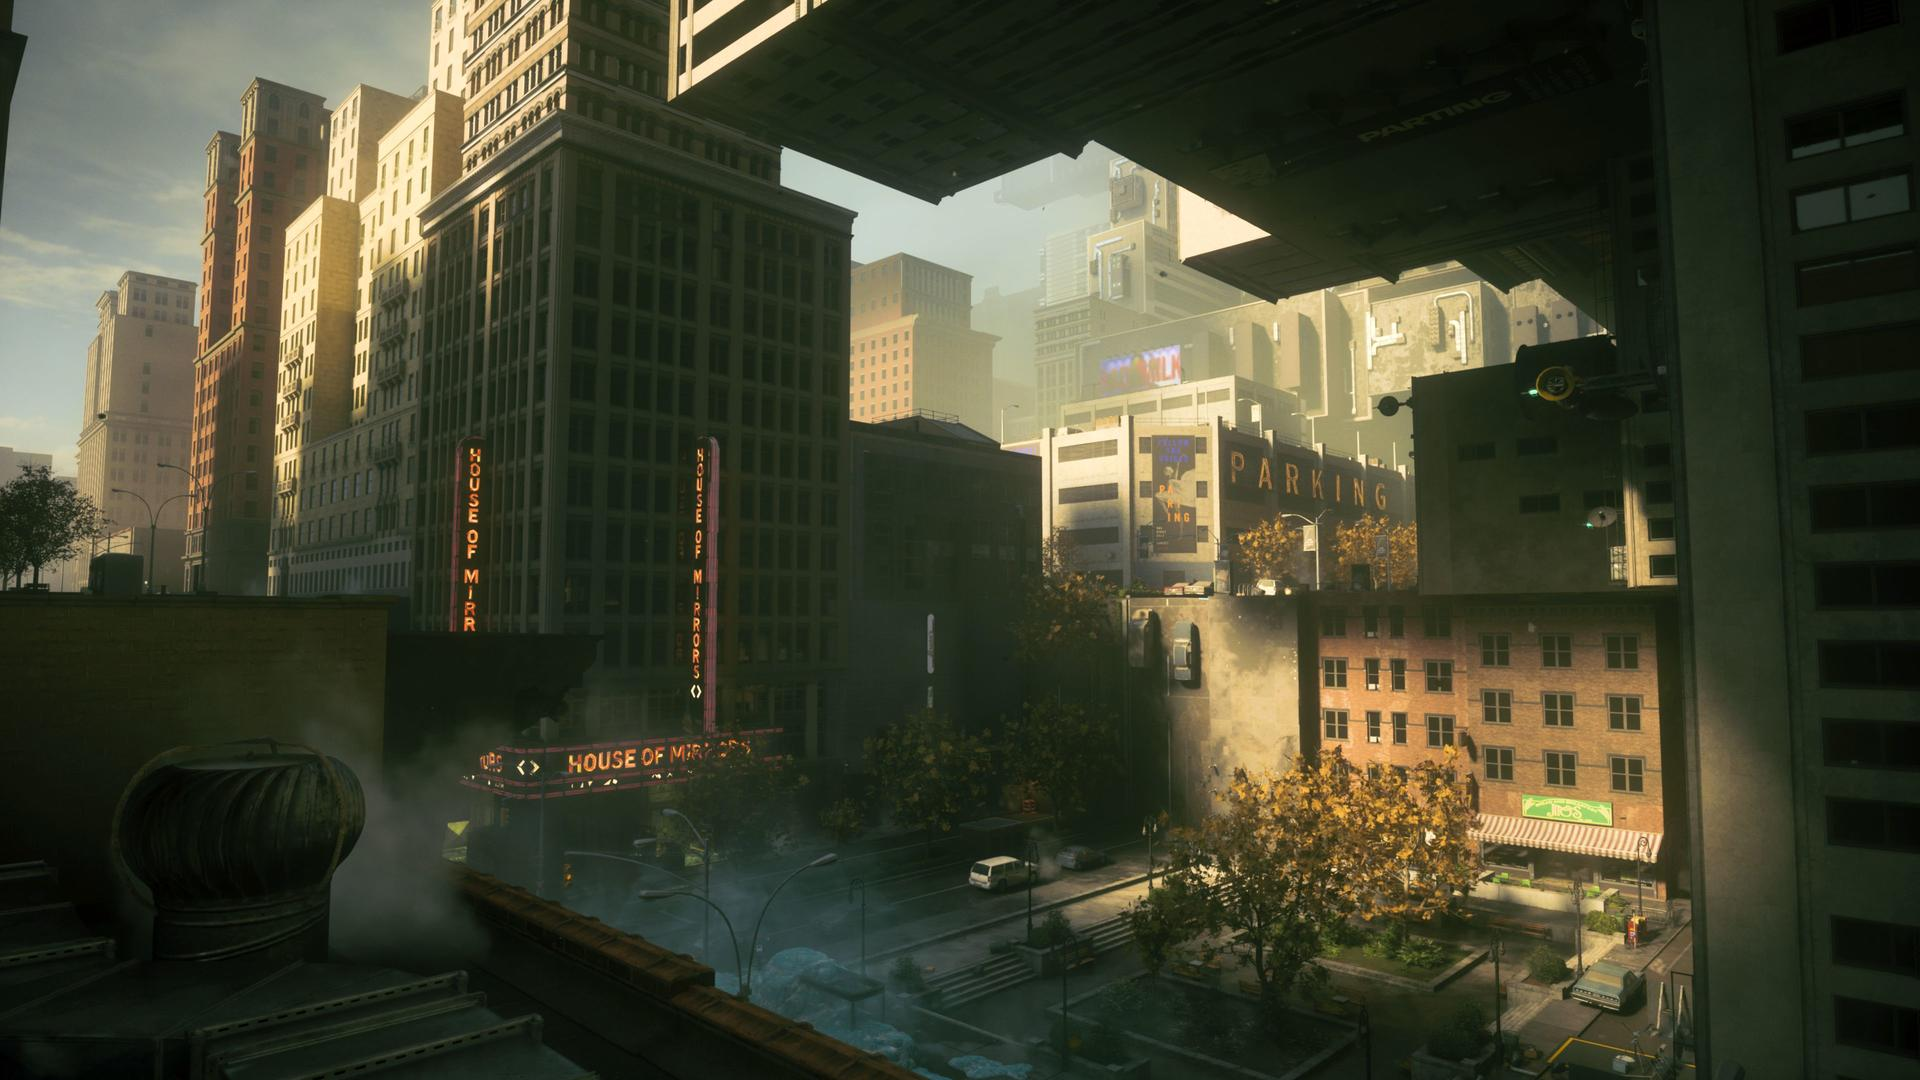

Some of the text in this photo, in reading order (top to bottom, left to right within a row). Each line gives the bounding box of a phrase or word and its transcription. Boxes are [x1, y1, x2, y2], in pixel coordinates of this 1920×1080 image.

[1358, 90, 1512, 142] PARTING
[1231, 450, 1387, 511] PARKING
[463, 448, 482, 632] HOUSE OF MIRR
[692, 448, 704, 679] HOUSE OF MIRRORS
[568, 748, 637, 774] HOUSE
[641, 746, 666, 767] OF
